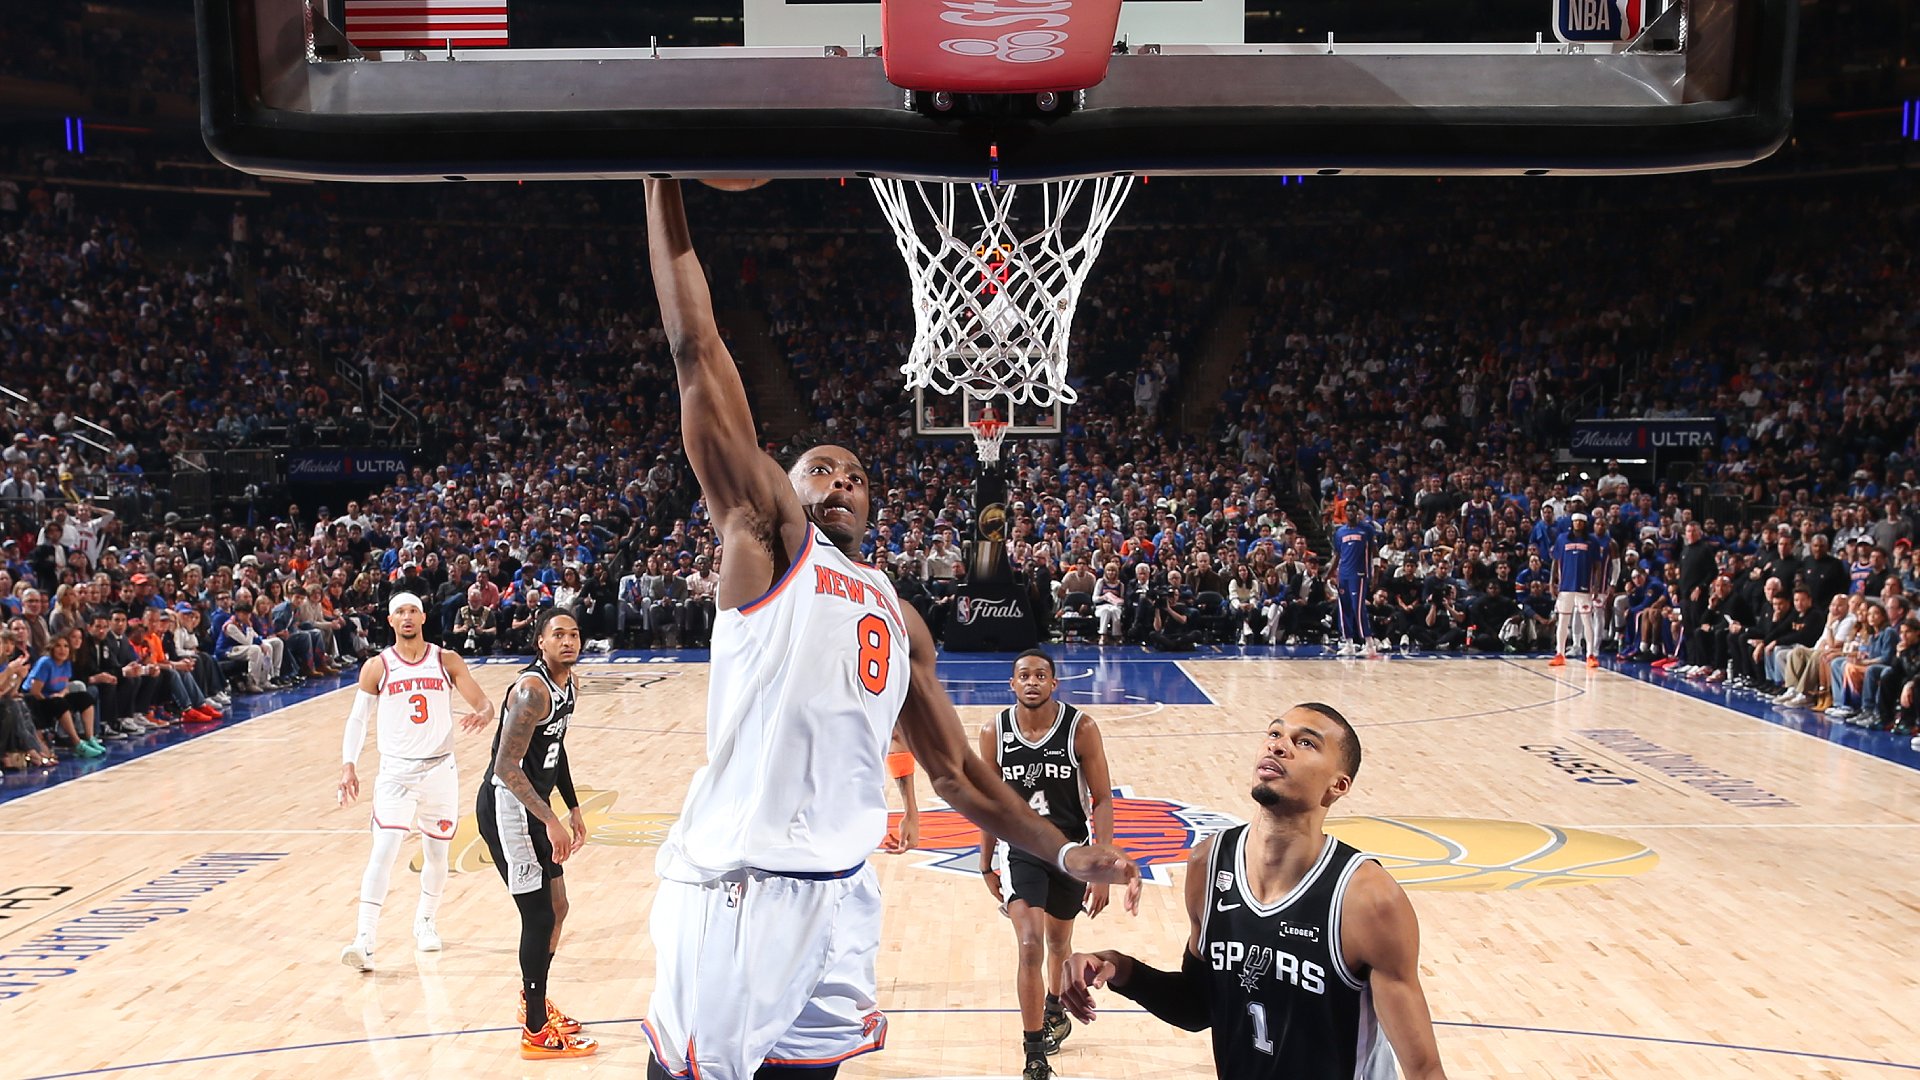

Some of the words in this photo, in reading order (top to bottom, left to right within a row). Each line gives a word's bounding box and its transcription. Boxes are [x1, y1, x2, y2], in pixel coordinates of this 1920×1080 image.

[1568, 0, 1610, 31] NBA
[1651, 431, 1714, 447] ULTRA
[356, 460, 406, 473] ULTRA
[814, 564, 866, 605] NEW
[964, 597, 1024, 626] Finals
[857, 612, 891, 697] 8
[387, 678, 413, 696] NEW
[415, 677, 444, 691] YORK
[408, 693, 429, 725] 3
[1028, 790, 1051, 816] 4
[111, 852, 290, 902] MADISON
[1284, 926, 1314, 938] LEDGER
[1210, 941, 1326, 995] SPURS
[1246, 1000, 1274, 1056] 1
